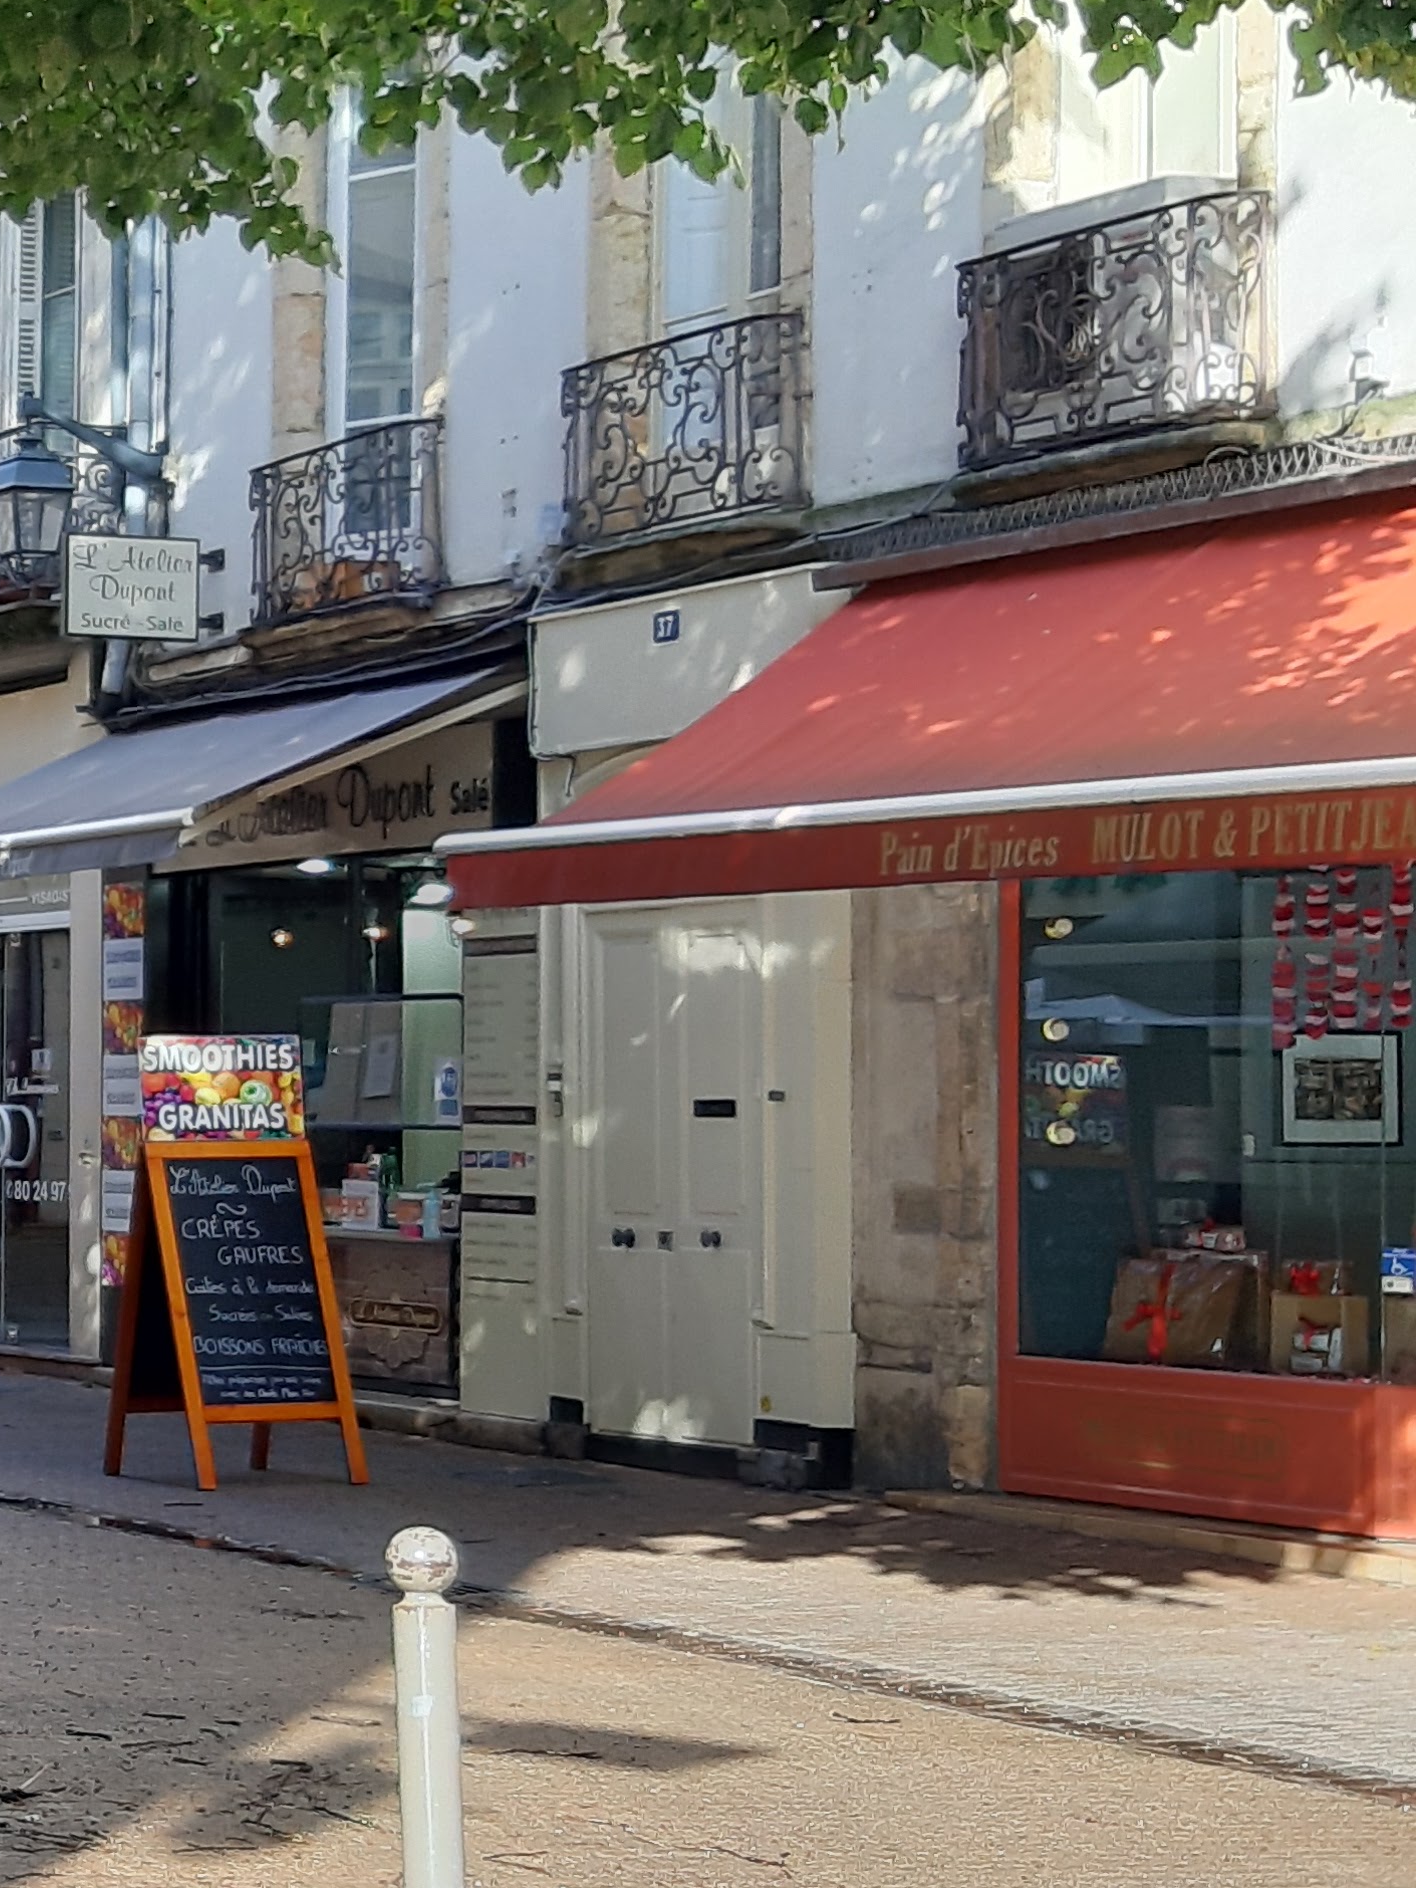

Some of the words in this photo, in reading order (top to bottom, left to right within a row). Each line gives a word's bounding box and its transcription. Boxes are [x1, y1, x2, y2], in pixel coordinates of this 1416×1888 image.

[89, 573, 177, 607] Dupont
[657, 615, 674, 638] 37
[880, 829, 933, 876] Pain
[1091, 811, 1204, 865] MULOT
[1212, 809, 1237, 858] &
[142, 1043, 296, 1073] SMOOTHIES
[157, 1104, 287, 1131] GRANITAS
[218, 1245, 304, 1266] GAUFRES
[193, 1335, 266, 1356] BOISSONS
